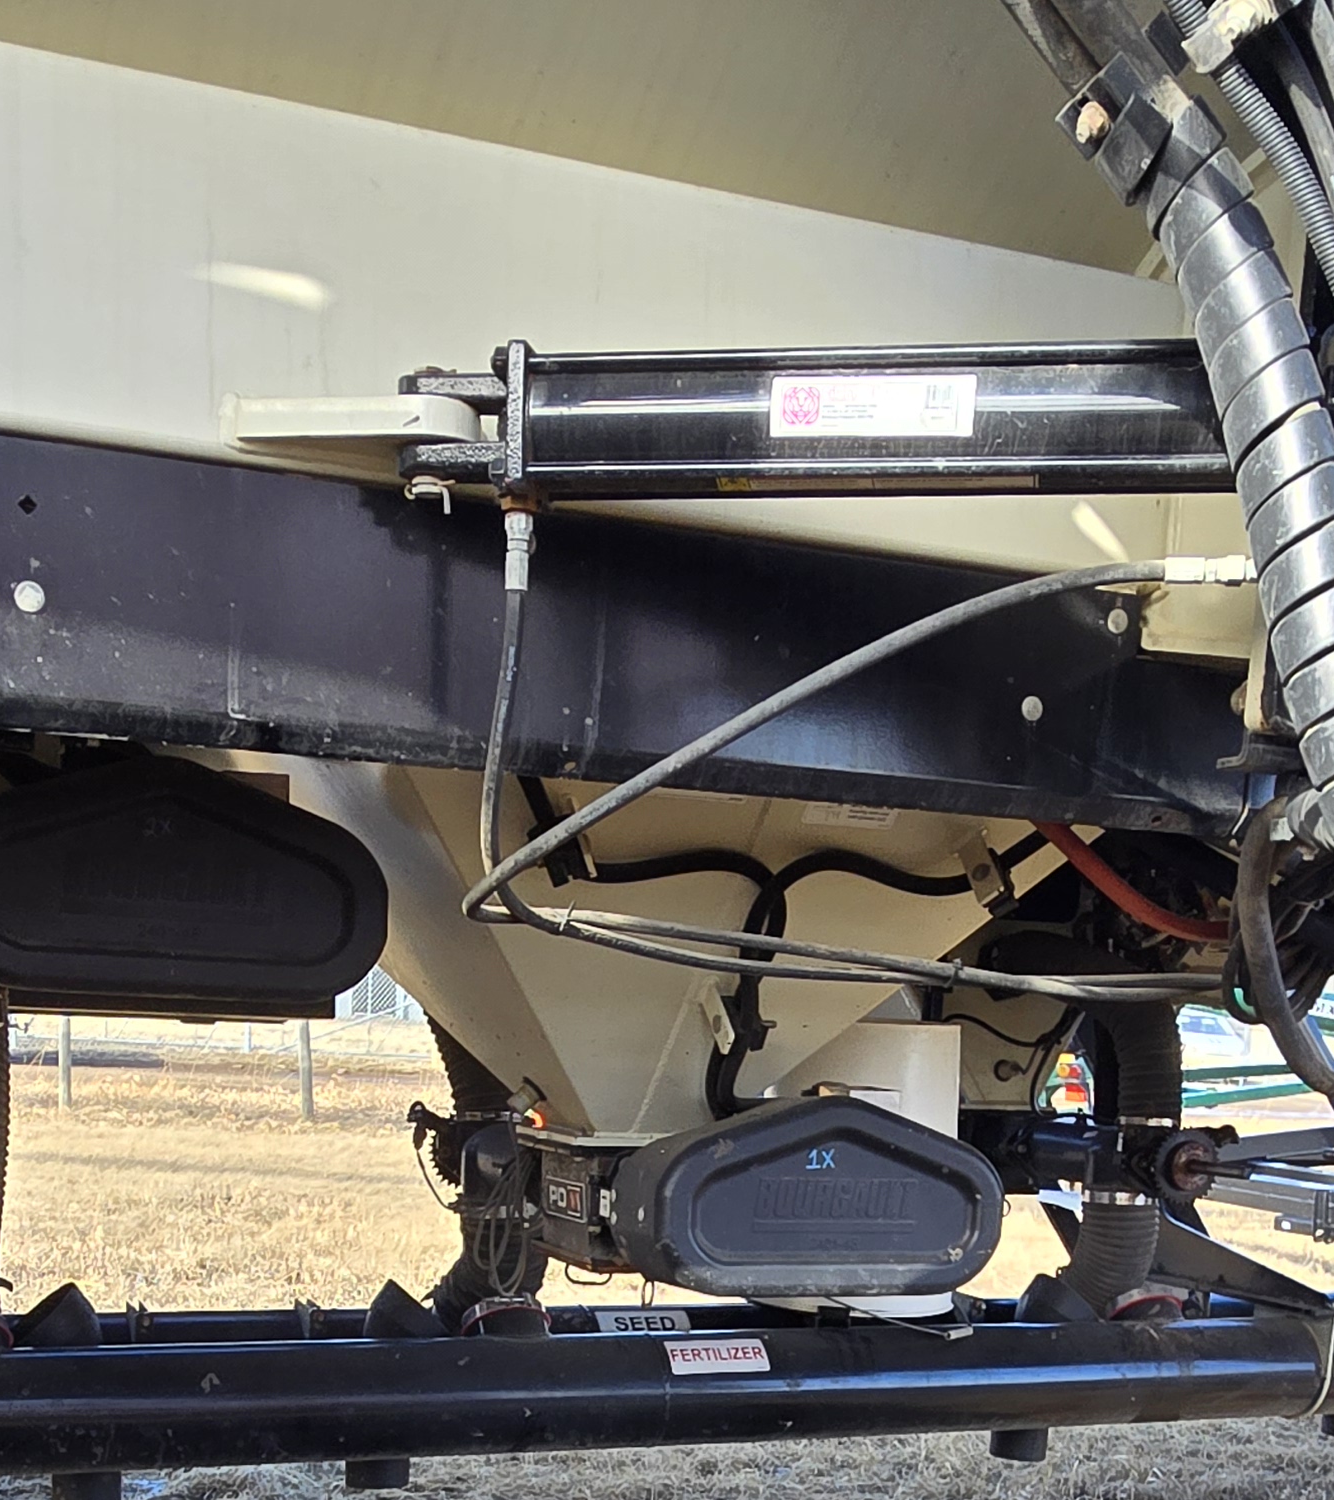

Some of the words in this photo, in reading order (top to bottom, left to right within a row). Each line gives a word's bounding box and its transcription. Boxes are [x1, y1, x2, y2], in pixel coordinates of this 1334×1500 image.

[805, 1148, 836, 1170] 1X
[614, 1316, 676, 1332] SEED
[670, 1346, 765, 1363] FERTILIZER
